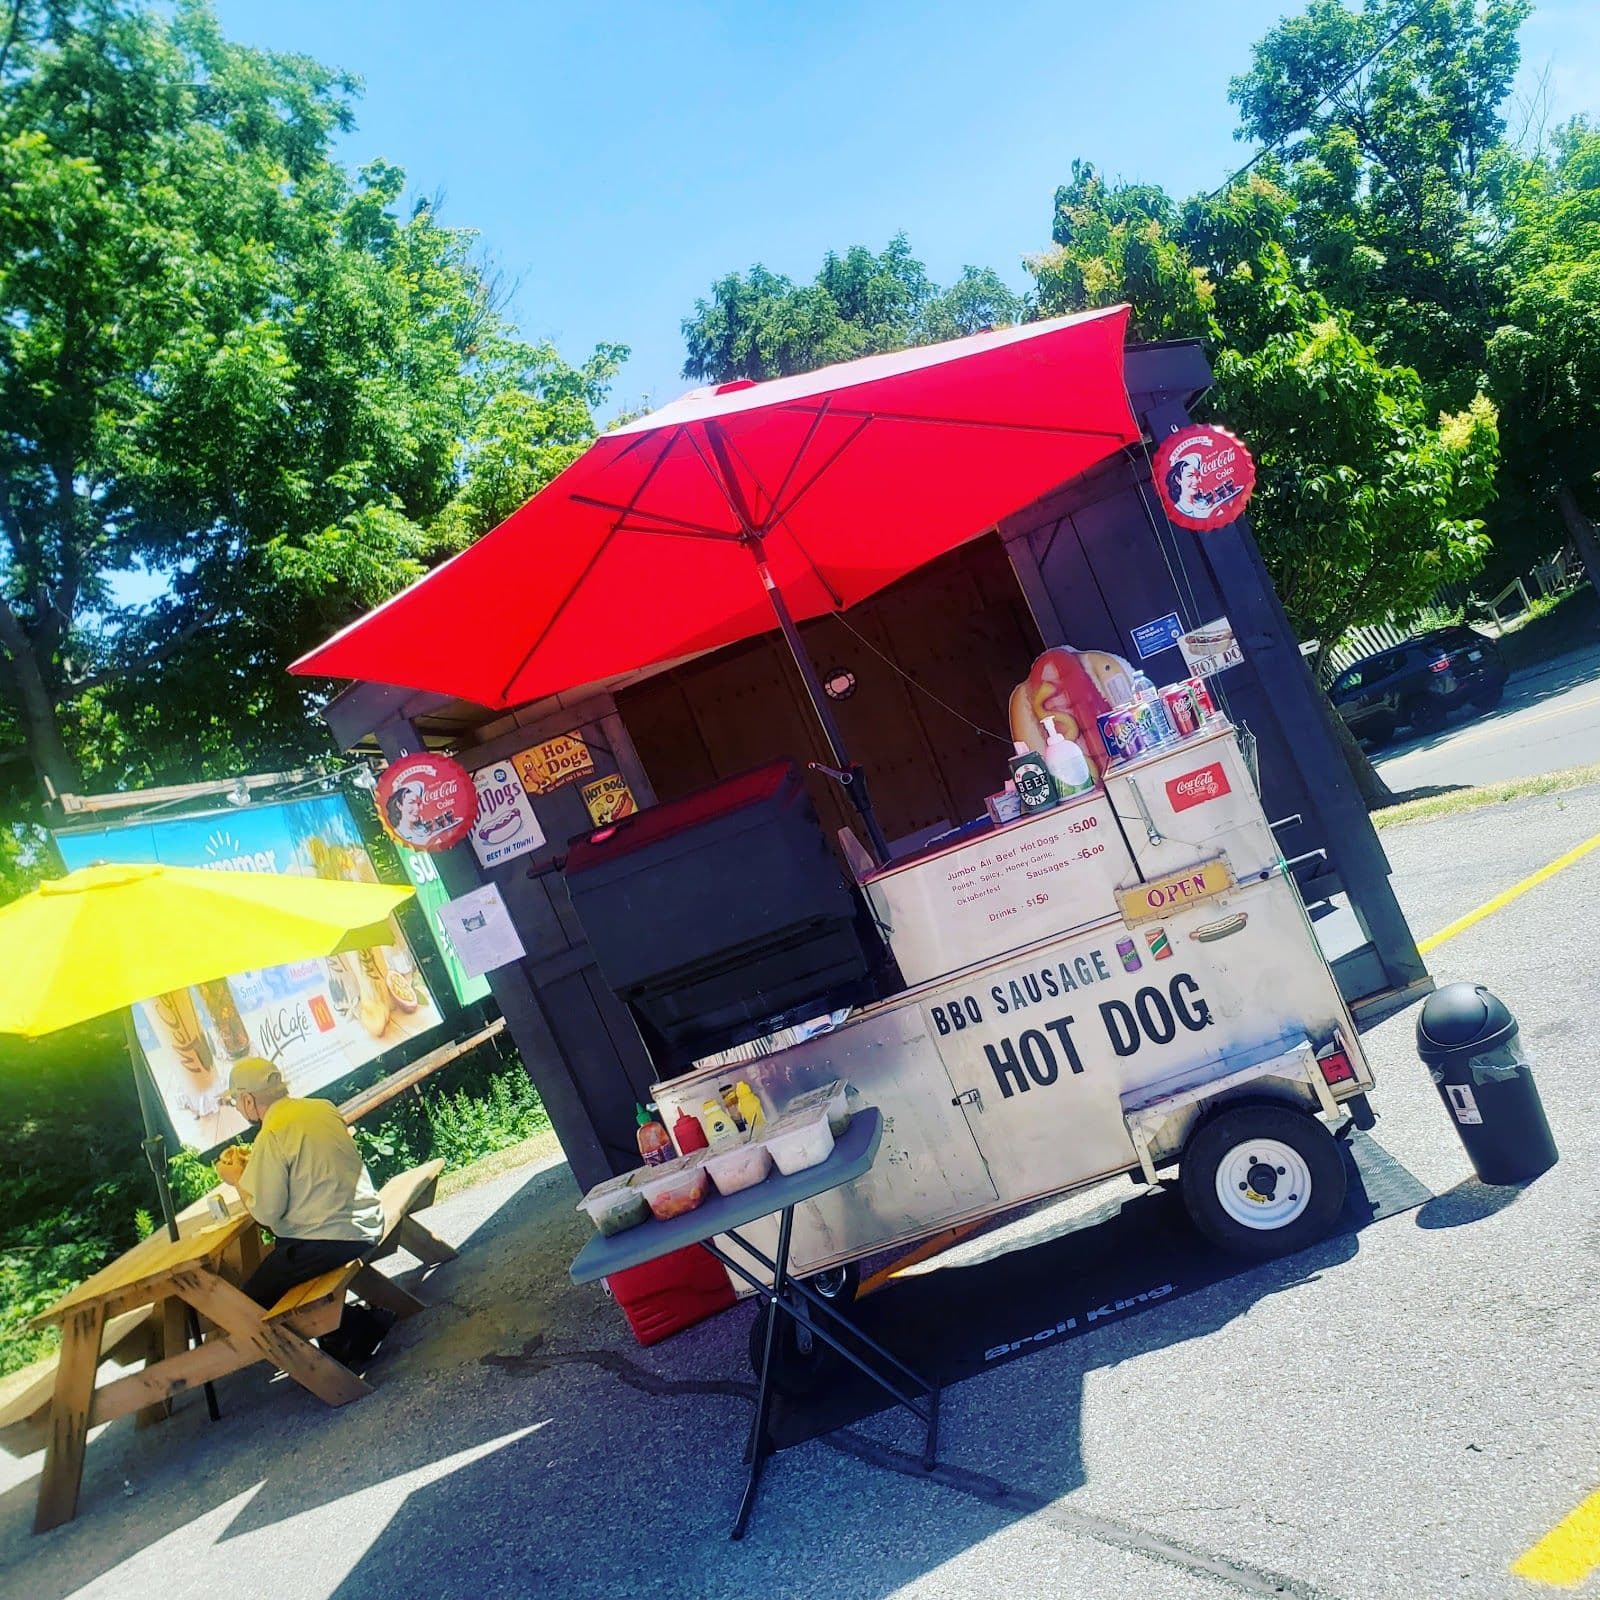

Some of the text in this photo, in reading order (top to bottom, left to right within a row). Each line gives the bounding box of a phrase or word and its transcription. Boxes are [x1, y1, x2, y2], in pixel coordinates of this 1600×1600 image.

[1215, 467, 1235, 480] Coke
[1191, 656, 1216, 677] HOT
[541, 739, 573, 760] Hot
[546, 749, 588, 775] Dogs
[584, 779, 626, 803] HOT DOGS
[1018, 774, 1049, 792] BEER
[483, 782, 521, 815] Dogs
[486, 836, 534, 862] BEST IN TOWN!
[947, 865, 976, 881] Jumbo
[980, 858, 992, 868] All
[996, 849, 1017, 863] Beef
[1020, 842, 1037, 854] Hot
[1037, 834, 1060, 847] Dogs
[1068, 816, 1098, 834] $5.00
[1006, 861, 1029, 873] Honey
[1026, 859, 1070, 880] Sausages
[1077, 844, 1105, 860] $6.00
[957, 886, 1001, 906] Oktoberfest
[1147, 873, 1206, 908] OPEN
[989, 907, 1017, 922] Drinks
[240, 980, 264, 999] Small
[931, 950, 1111, 1036] BBQ SAUSAGE
[259, 1001, 312, 1058] McCafé
[983, 973, 1215, 1099] HOT DOG
[984, 1283, 1173, 1361] Broil King
